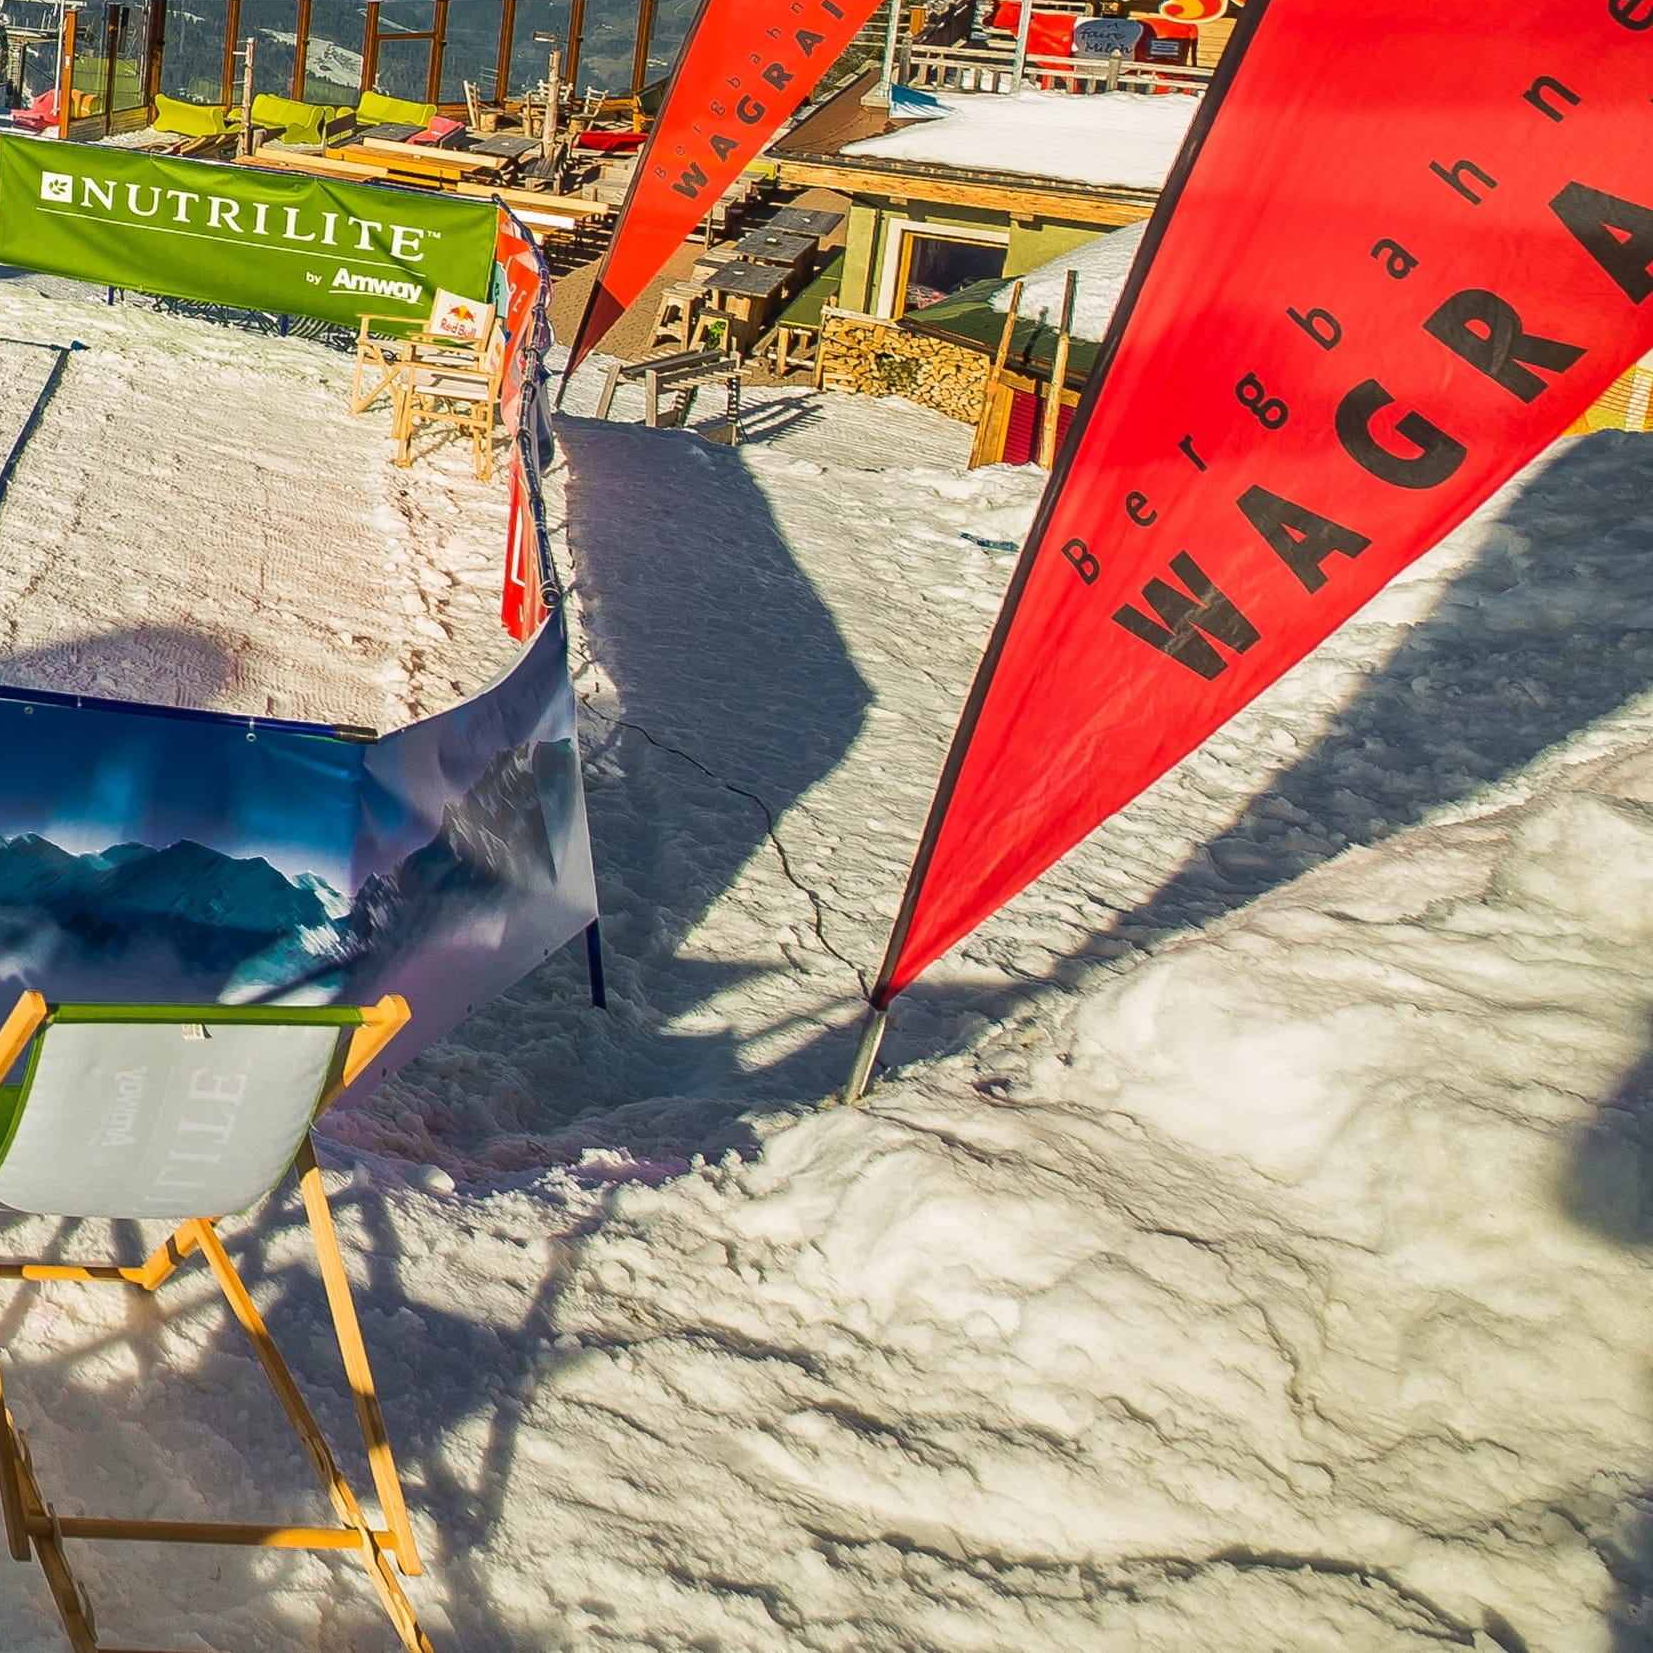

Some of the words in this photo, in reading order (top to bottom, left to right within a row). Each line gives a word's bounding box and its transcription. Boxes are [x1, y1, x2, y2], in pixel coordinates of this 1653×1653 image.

[305, 272, 323, 286] by
[333, 267, 424, 304] Amway
[439, 318, 458, 334] Red
